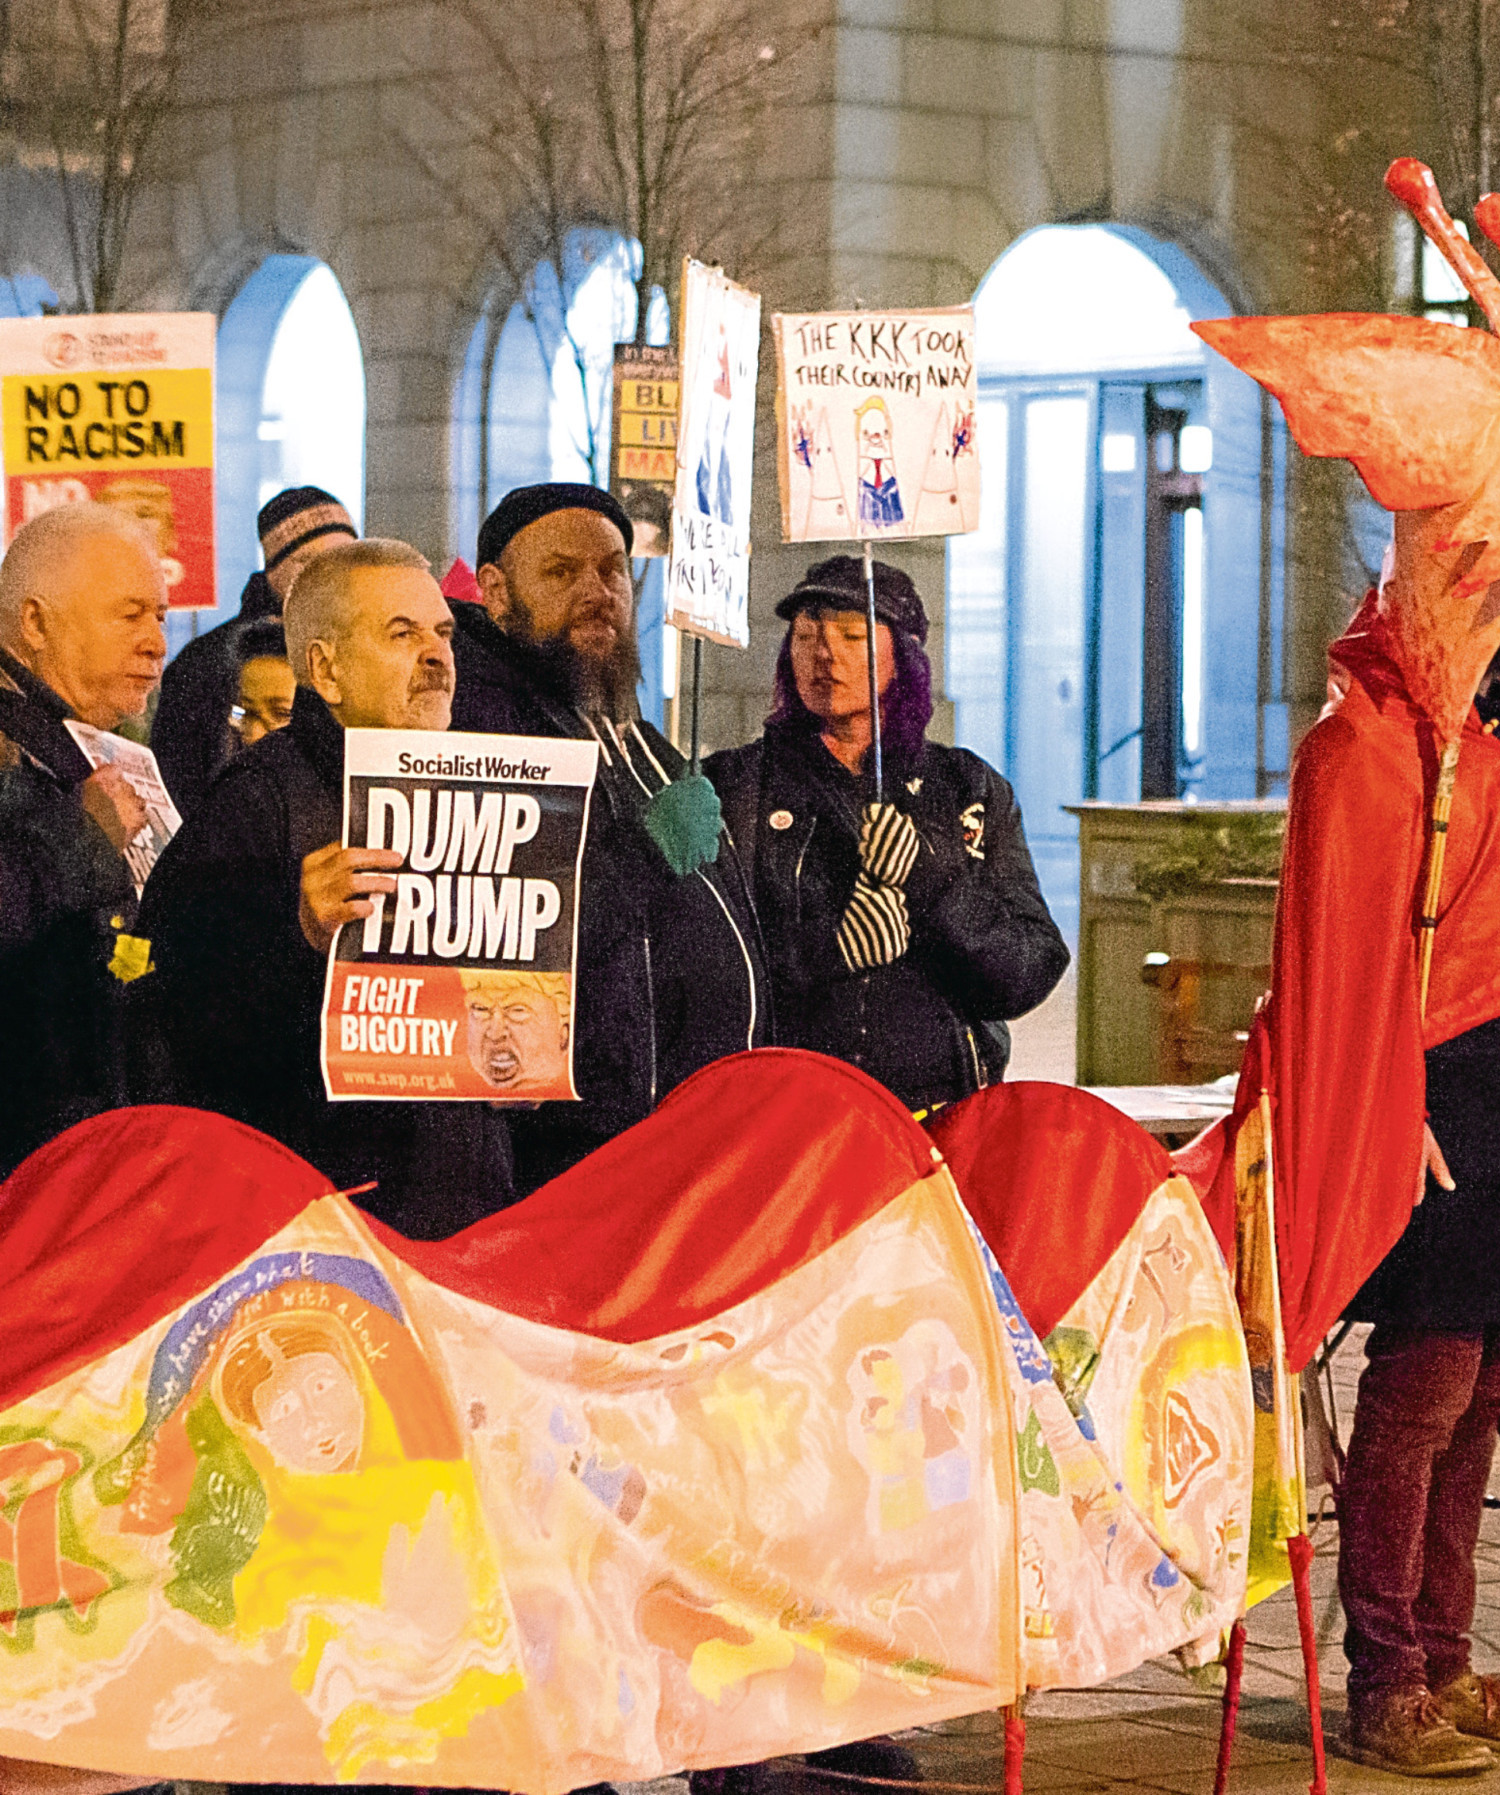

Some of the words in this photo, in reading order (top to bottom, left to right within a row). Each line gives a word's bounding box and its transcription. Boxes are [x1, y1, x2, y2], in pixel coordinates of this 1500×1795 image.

[794, 321, 839, 358] THE
[848, 321, 912, 368] KKK
[910, 326, 969, 364] TOOK
[24, 382, 82, 421] NO
[96, 379, 151, 419] TO
[795, 363, 851, 387] THEIR
[852, 365, 921, 398] COUNTRY
[25, 421, 185, 463] RACISM
[641, 419, 677, 442] LIV
[398, 752, 483, 778] Socialist
[485, 756, 551, 780] Worker
[365, 786, 541, 875] DUMP
[354, 871, 562, 962] TRUMP
[341, 974, 424, 1016] FIGHT
[340, 1014, 458, 1057] BIGOTRY
[342, 1071, 457, 1092] www.swp.org.uk
[281, 1286, 331, 1308] with
[351, 1310, 390, 1365] book
